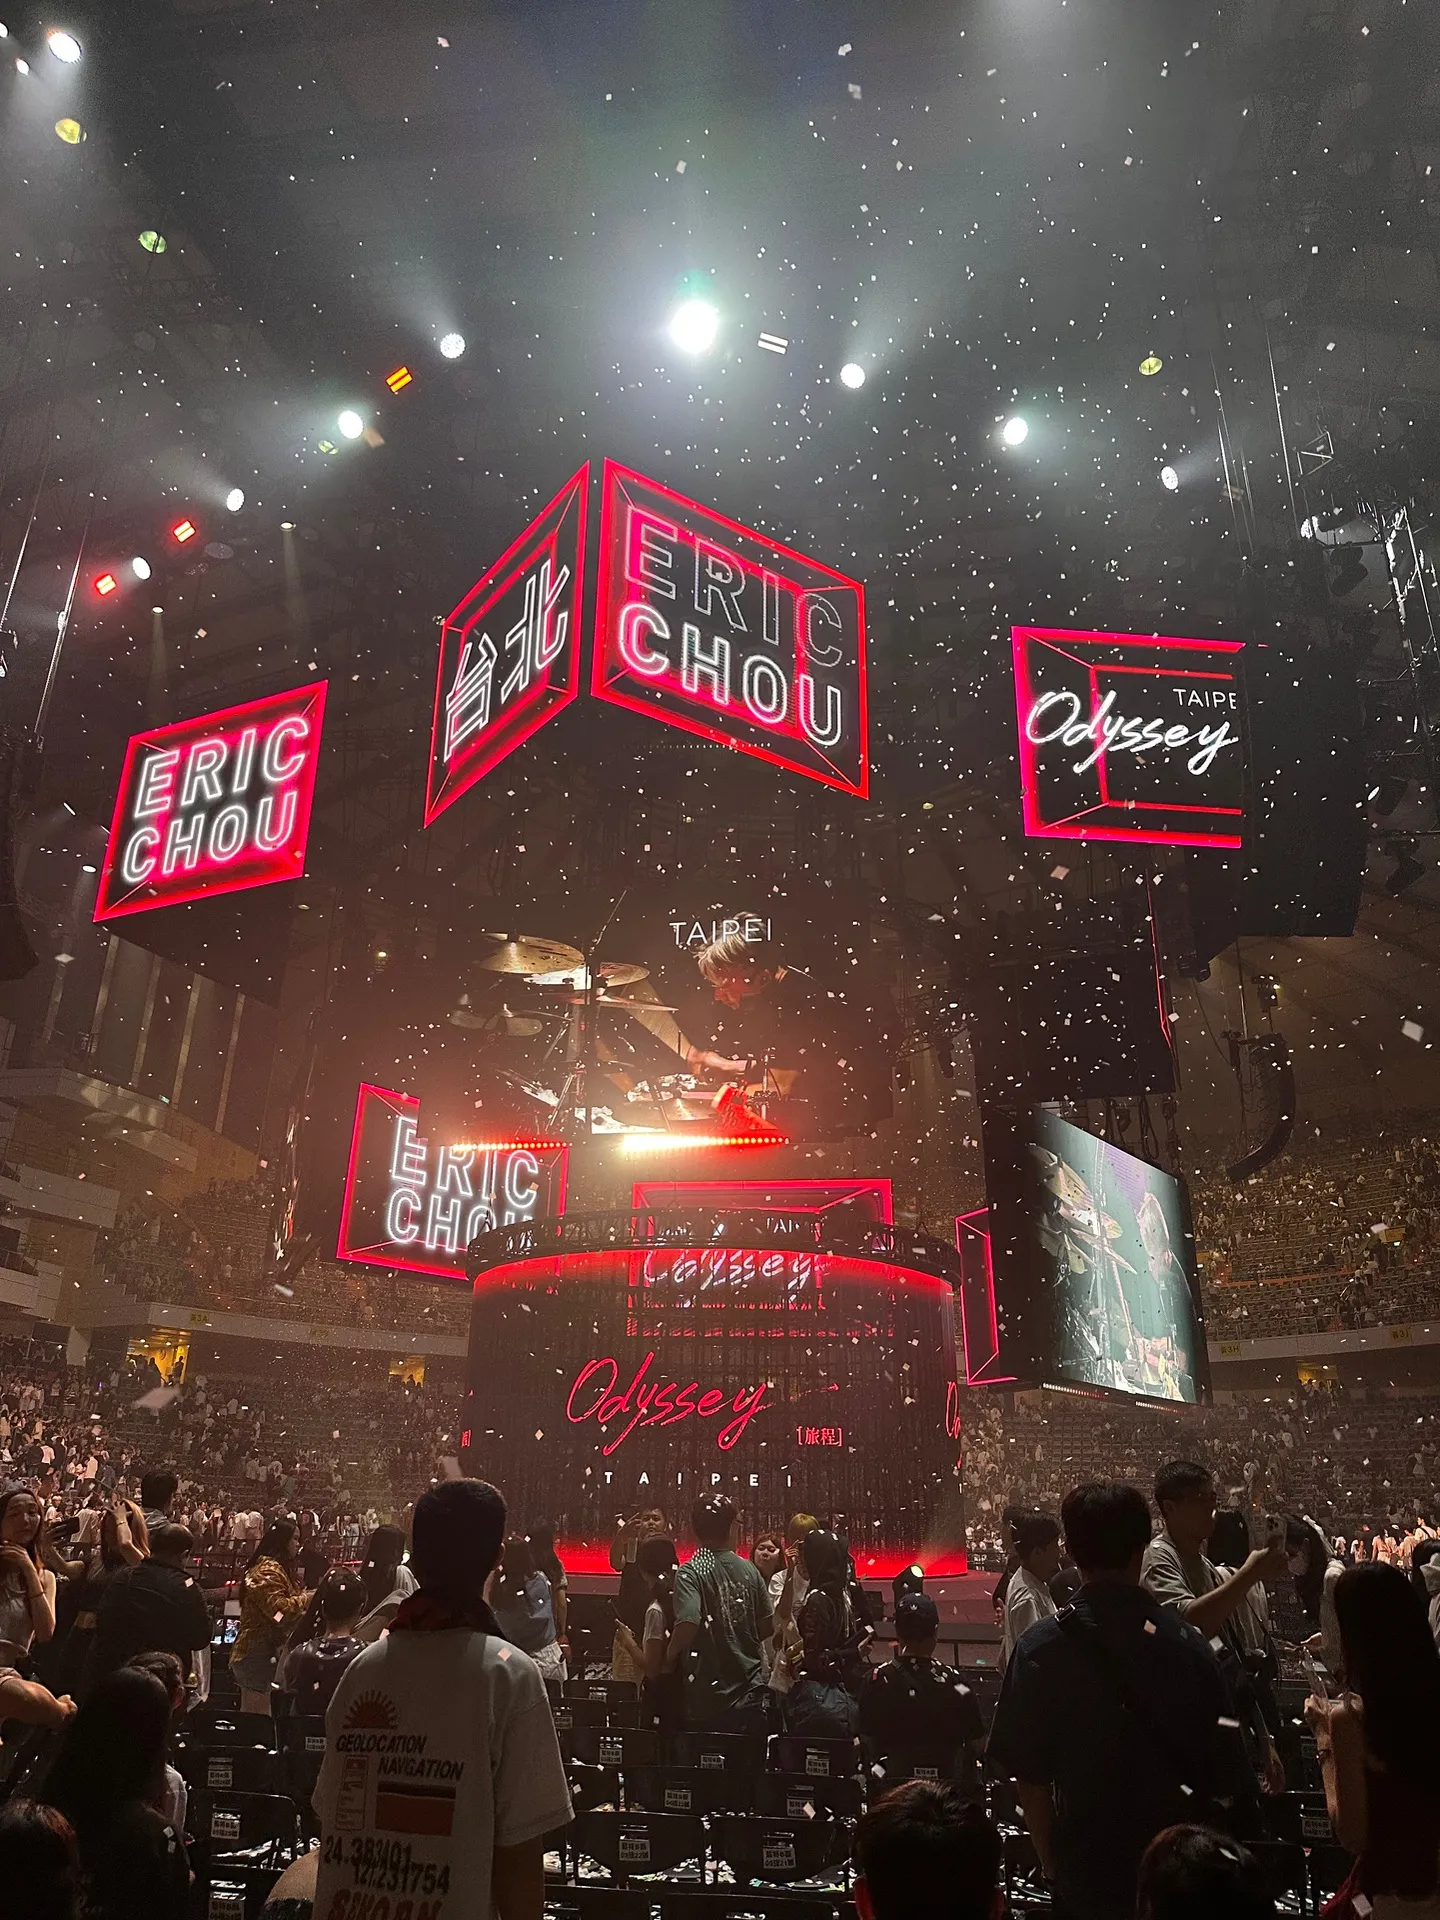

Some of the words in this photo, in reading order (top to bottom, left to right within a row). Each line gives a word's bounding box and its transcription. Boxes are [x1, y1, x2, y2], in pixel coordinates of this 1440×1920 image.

[624, 504, 843, 668] ERIC
[444, 559, 570, 763] 台北
[618, 603, 842, 746] CHOU
[133, 716, 309, 818] ERIC
[1026, 689, 1239, 776] Odyssey
[122, 791, 298, 883] CHOU
[668, 918, 772, 945] TAIPEI
[390, 1116, 539, 1209] ERIC
[386, 1187, 533, 1253] CHO
[566, 1351, 776, 1456] Odyssey
[604, 1471, 792, 1488] TAIPEI
[335, 1734, 428, 1755] GEOLOCATION
